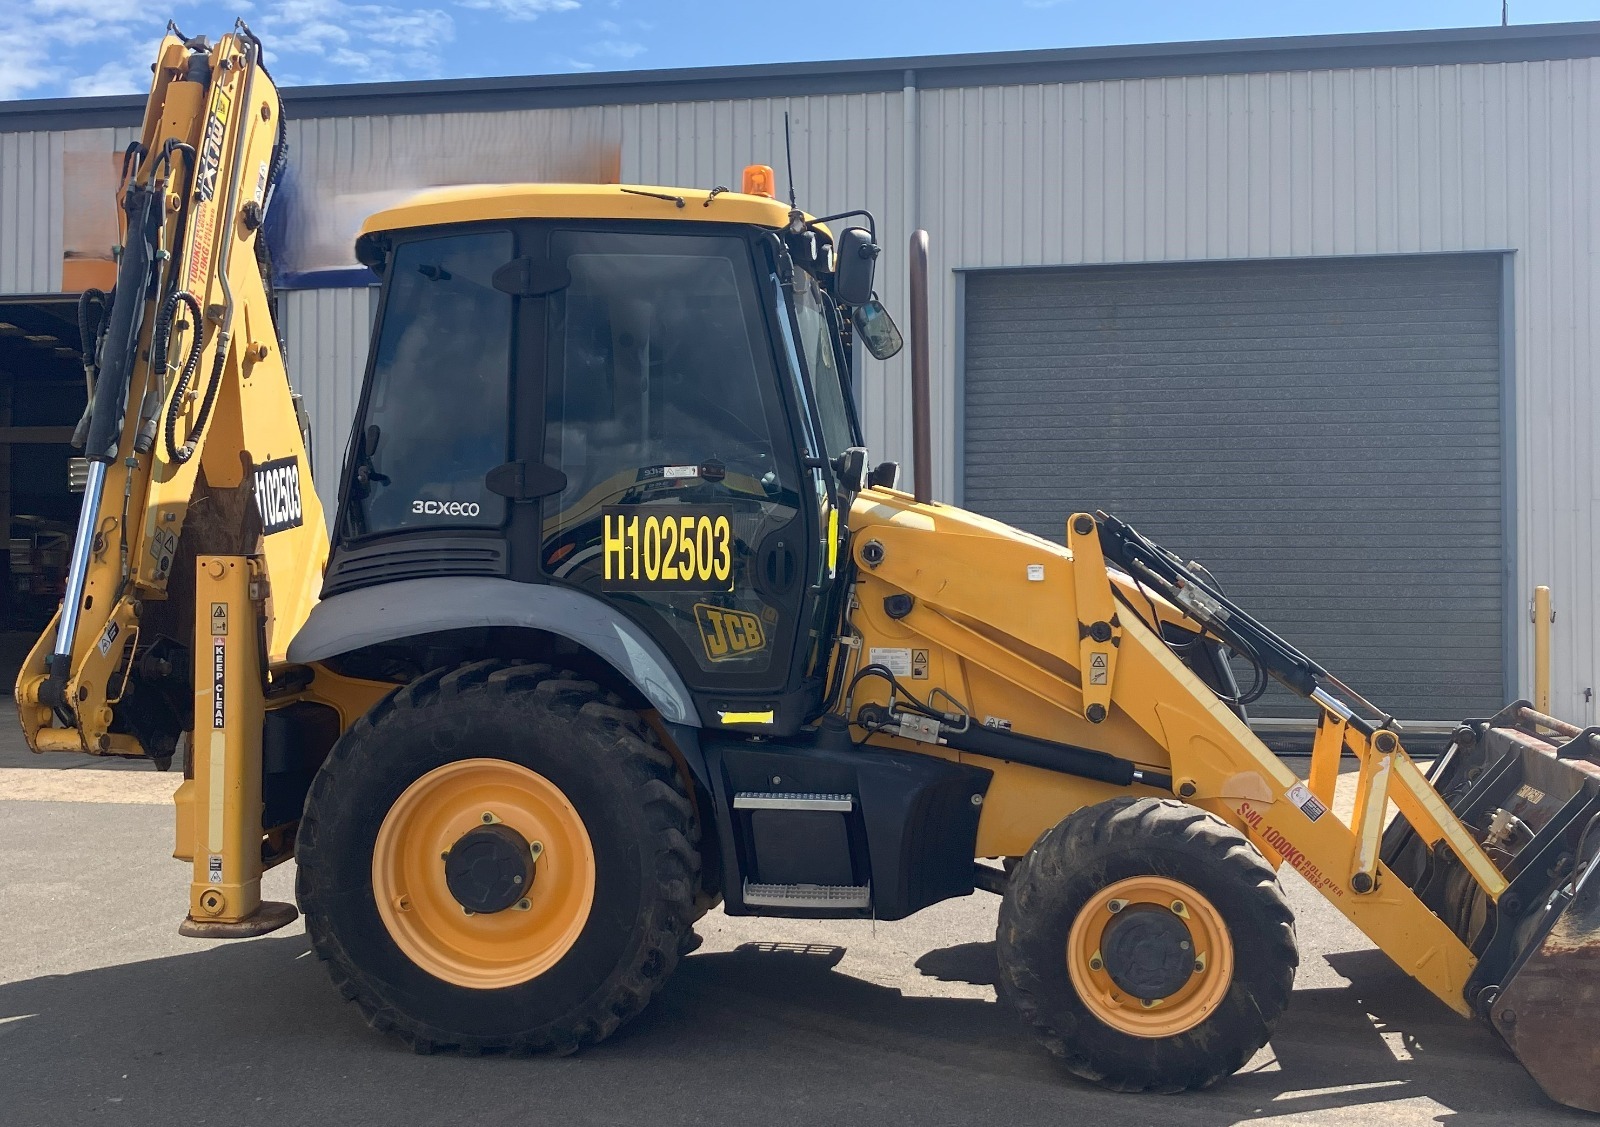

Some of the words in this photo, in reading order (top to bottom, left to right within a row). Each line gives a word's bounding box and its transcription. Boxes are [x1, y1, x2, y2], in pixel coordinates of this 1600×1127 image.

[190, 242, 201, 284] 1000KG
[198, 246, 209, 284] 719KG
[604, 514, 731, 581] H102503
[706, 609, 761, 656] JCB
[215, 646, 224, 681] KEEP
[214, 684, 224, 726] CLEAR
[1237, 802, 1263, 830] SWL
[1261, 825, 1305, 869] 1000KG
[1304, 860, 1324, 879] ROLL
[1324, 877, 1344, 897] OVER
